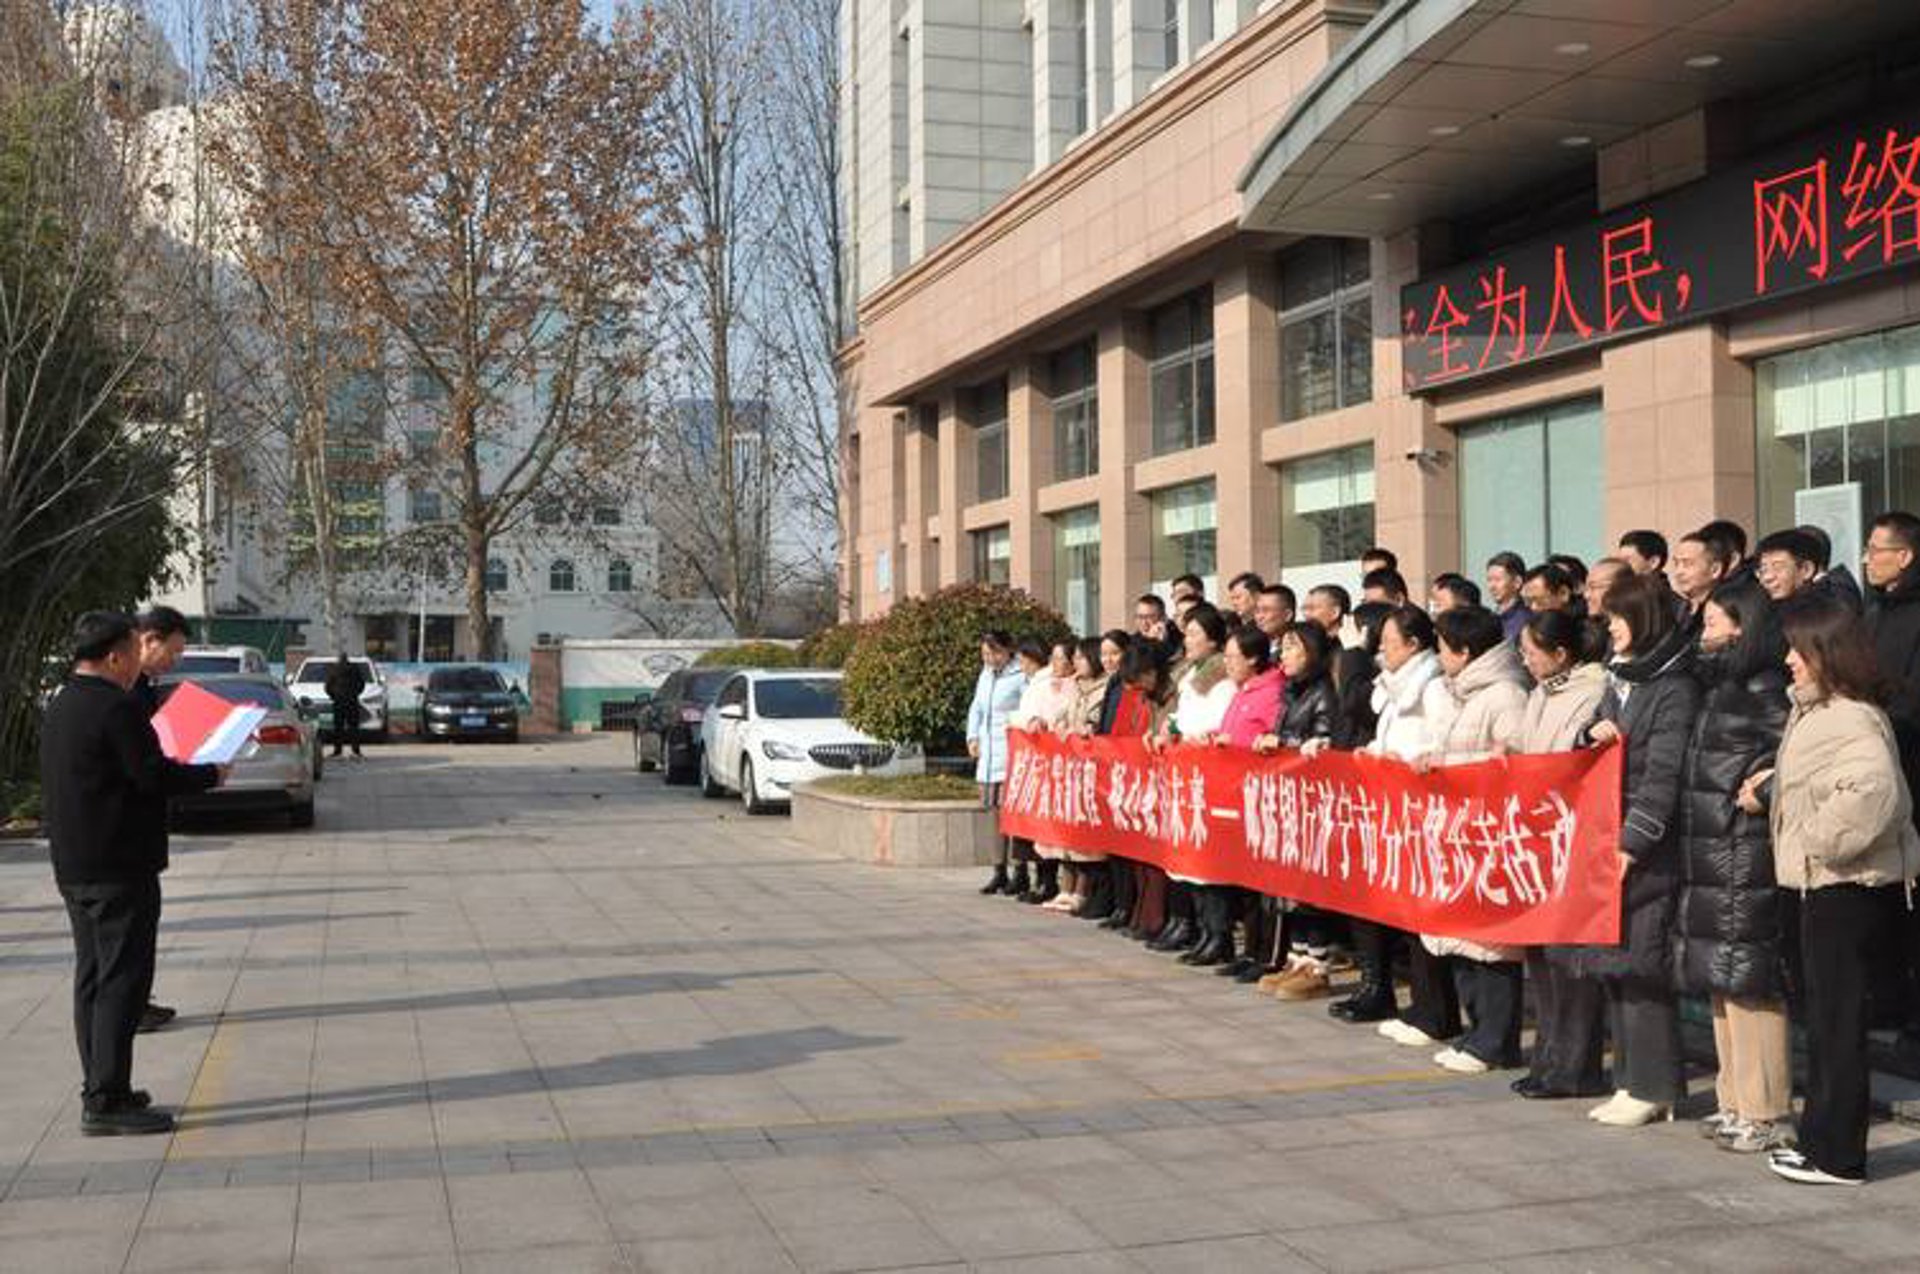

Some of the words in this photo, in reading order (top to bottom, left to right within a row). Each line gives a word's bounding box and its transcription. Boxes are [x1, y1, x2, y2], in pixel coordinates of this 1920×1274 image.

[1403, 129, 1920, 384] 全为人民，网络
